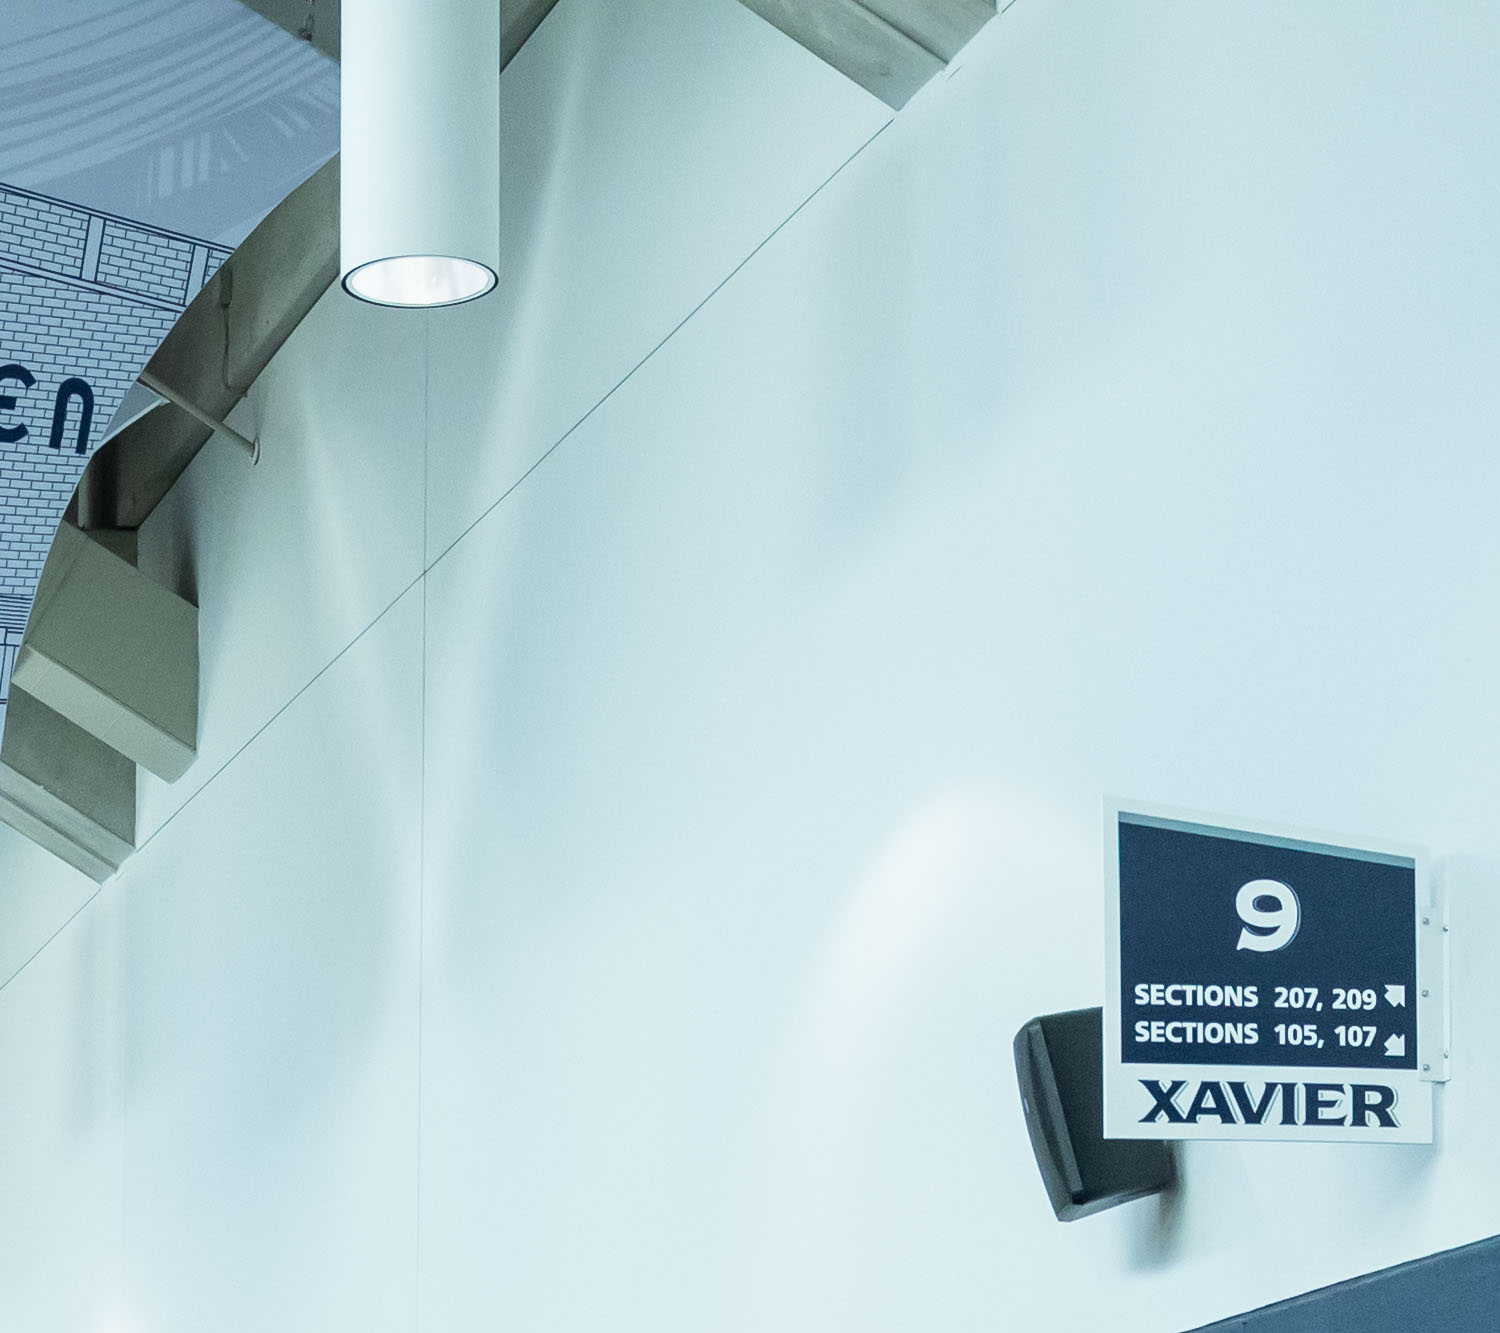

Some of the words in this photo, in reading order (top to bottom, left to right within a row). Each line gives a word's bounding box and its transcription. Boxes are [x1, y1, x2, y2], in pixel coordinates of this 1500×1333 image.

[1235, 879, 1301, 952] 9
[1135, 984, 1259, 1008] SECTIONS
[1274, 987, 1323, 1012] 207,
[1332, 988, 1377, 1010] 209
[1135, 1021, 1259, 1045] SECTIONS
[1274, 1024, 1324, 1048] 105,
[1334, 1026, 1377, 1047] 107
[1137, 1079, 1402, 1129] XAVIER
